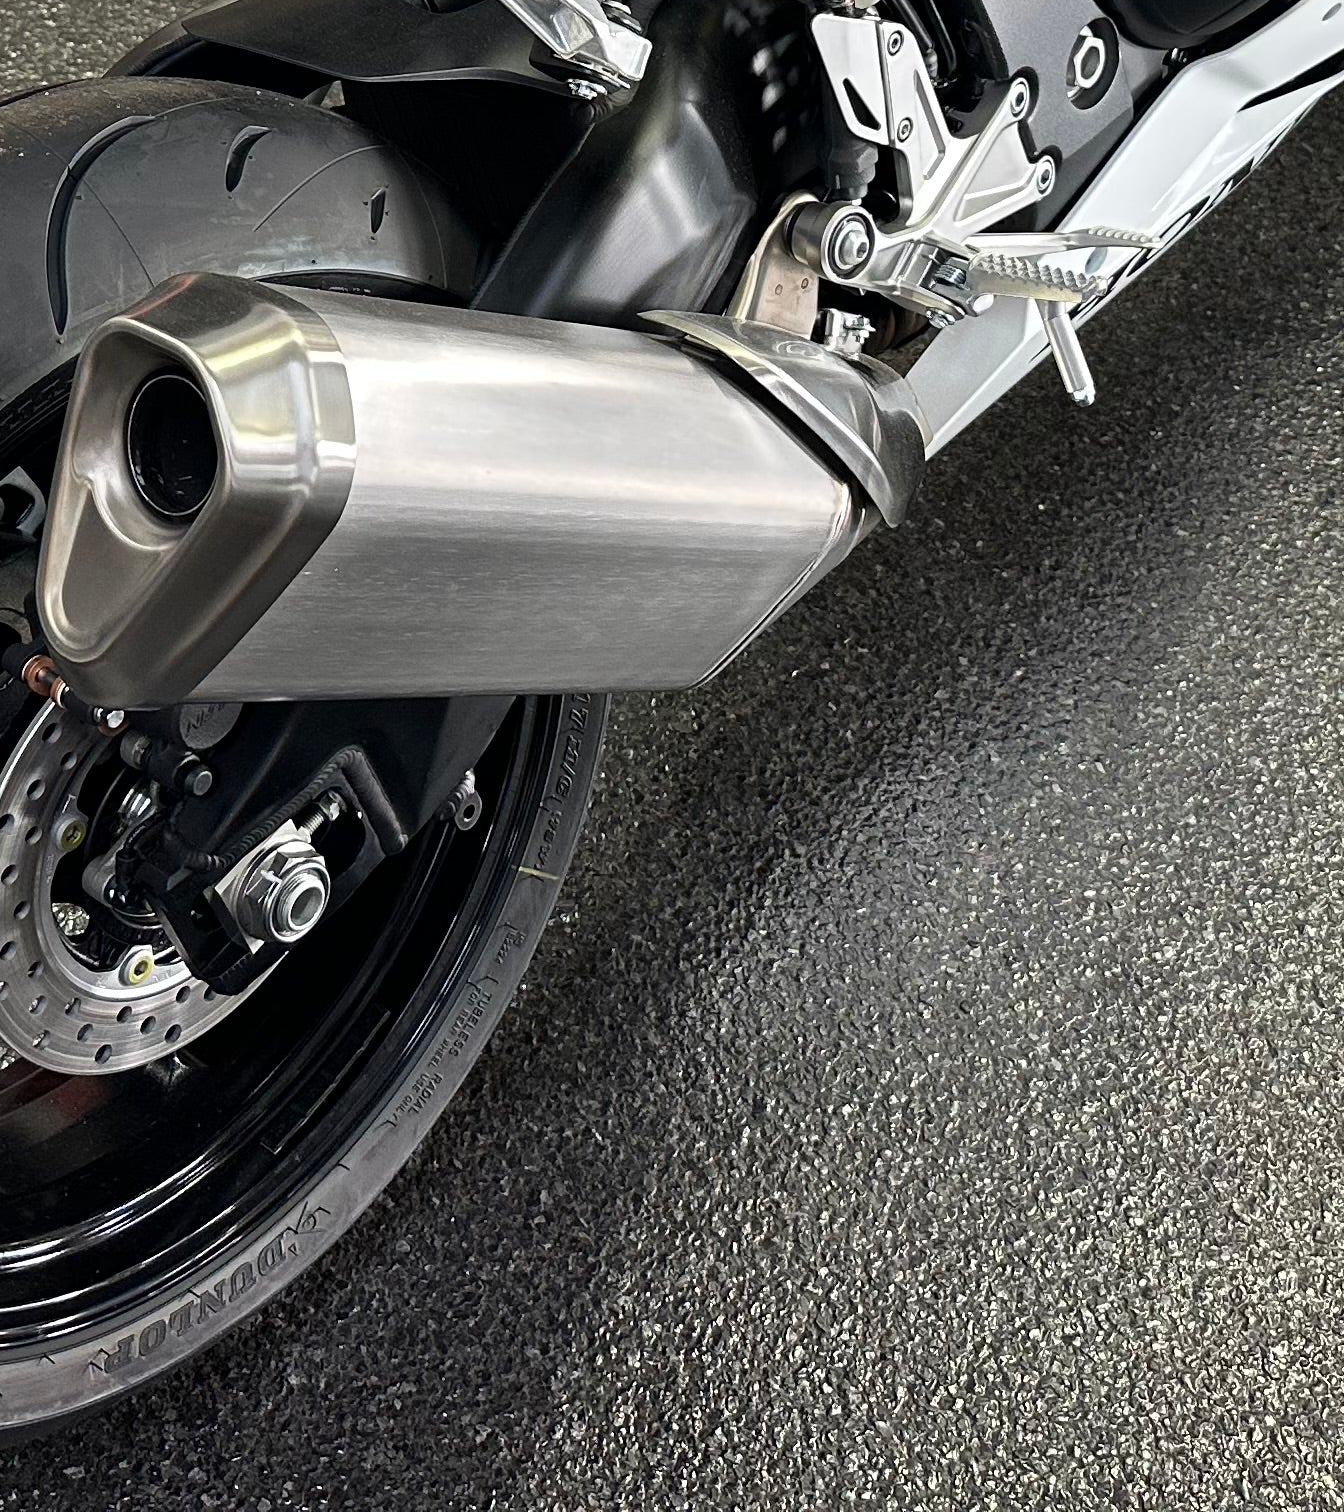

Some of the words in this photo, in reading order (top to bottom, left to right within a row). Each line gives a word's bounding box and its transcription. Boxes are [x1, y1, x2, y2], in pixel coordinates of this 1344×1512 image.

[447, 990, 493, 1059] TUBELESS
[407, 1071, 443, 1115] RADIAL
[104, 1234, 288, 1375] DUNLOP
